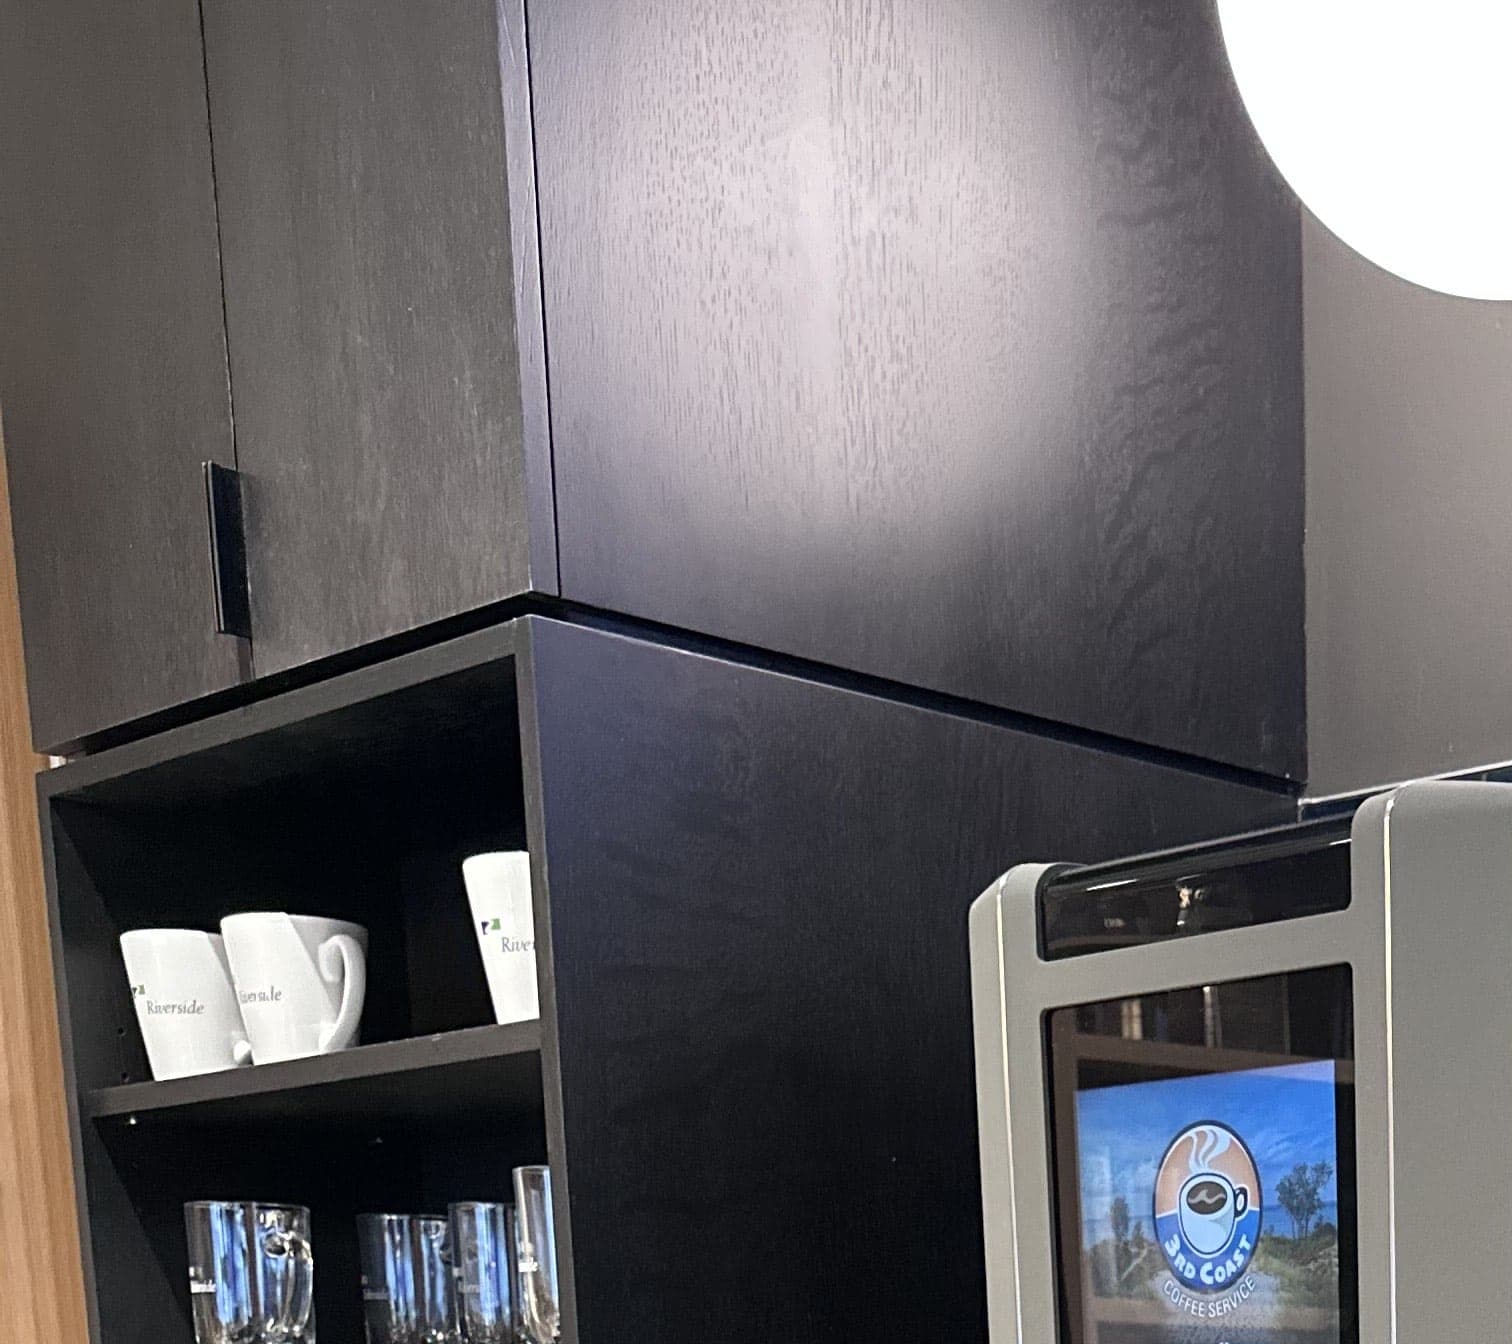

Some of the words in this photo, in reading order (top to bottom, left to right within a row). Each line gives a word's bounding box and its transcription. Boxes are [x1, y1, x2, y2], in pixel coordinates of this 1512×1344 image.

[147, 999, 205, 1016] Riverside
[1163, 1279, 1206, 1318] COFFEE
[1207, 1274, 1256, 1318] SERVICE
